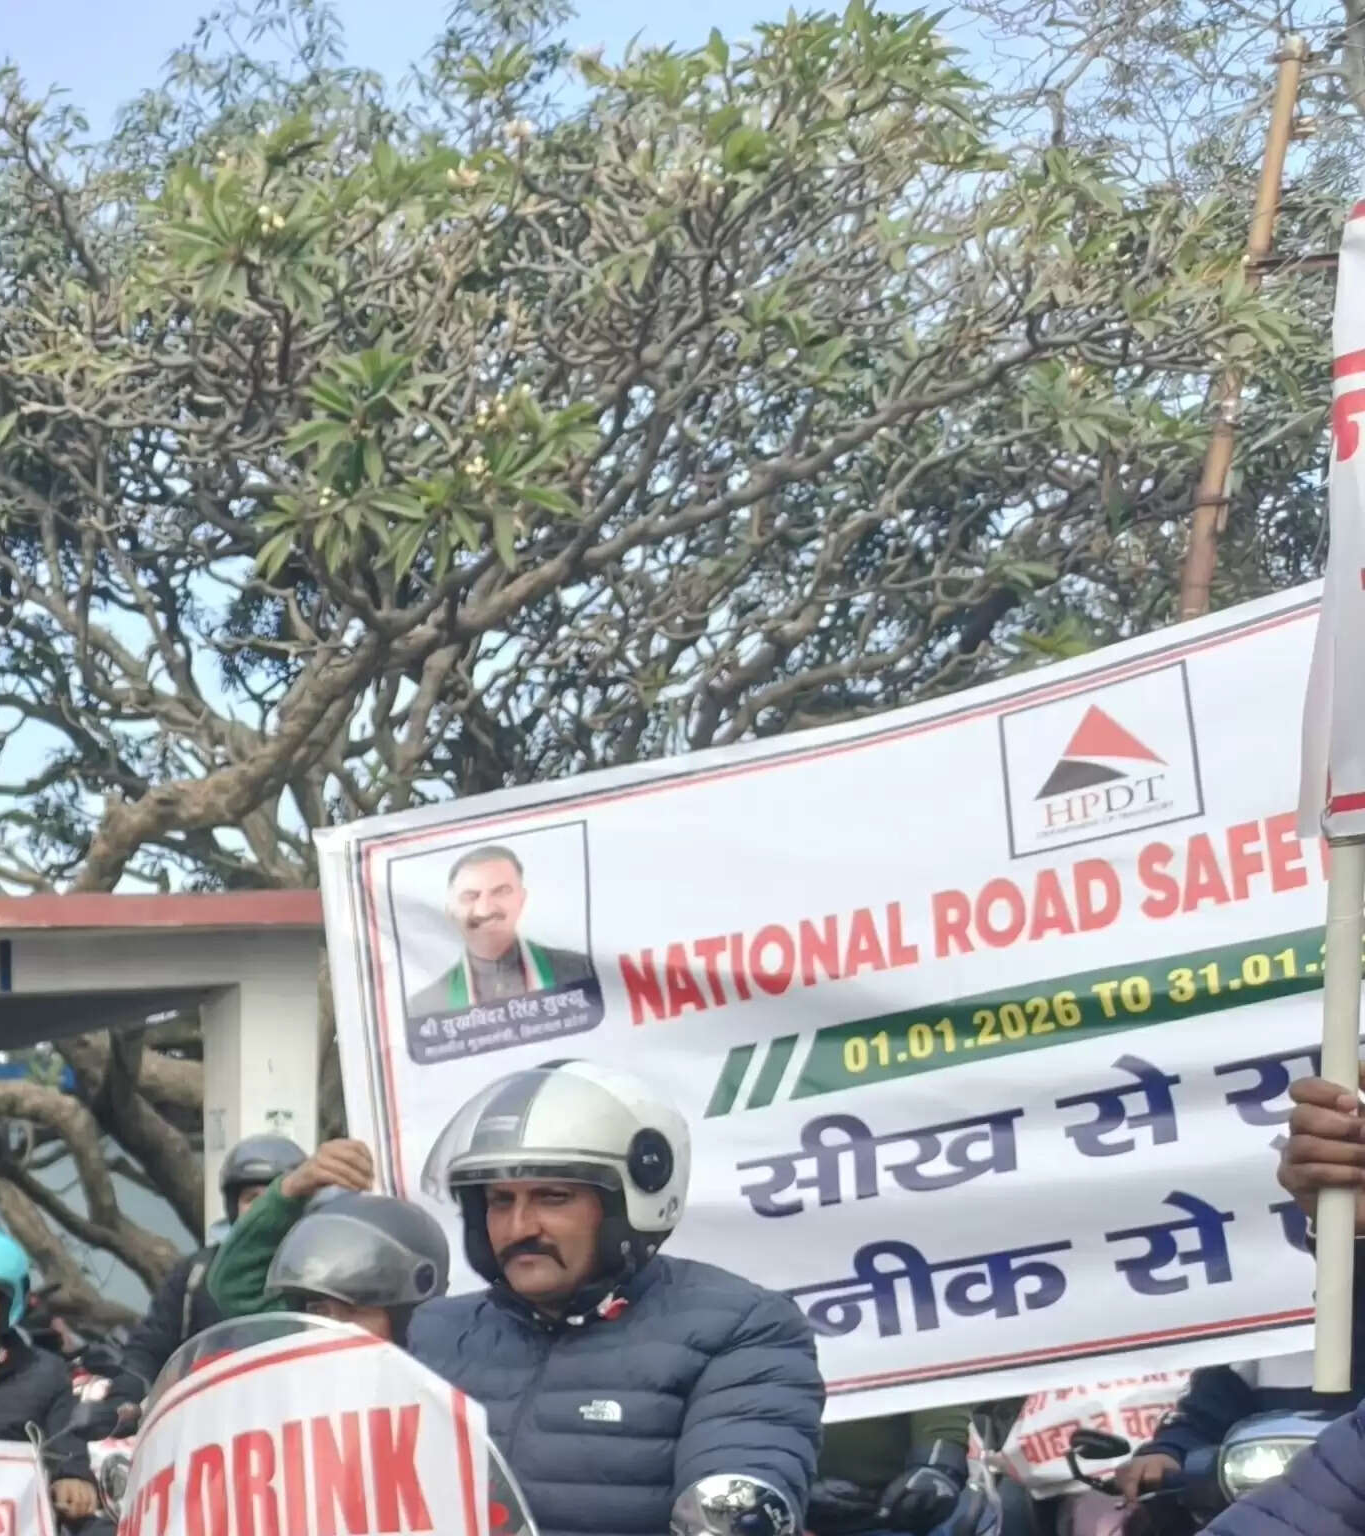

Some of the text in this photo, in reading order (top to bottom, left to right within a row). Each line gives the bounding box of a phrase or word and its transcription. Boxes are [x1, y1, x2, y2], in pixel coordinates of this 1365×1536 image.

[1043, 773, 1166, 828] HPDT
[618, 810, 1332, 1026] NATIONAL ROAD SAFE
[842, 994, 1082, 1074] 01.01.2026
[1091, 975, 1153, 1020] TO
[736, 1108, 1025, 1218] सीख
[1055, 1054, 1180, 1158] से
[789, 1240, 1072, 1338] नीक
[1105, 1190, 1235, 1296] से
